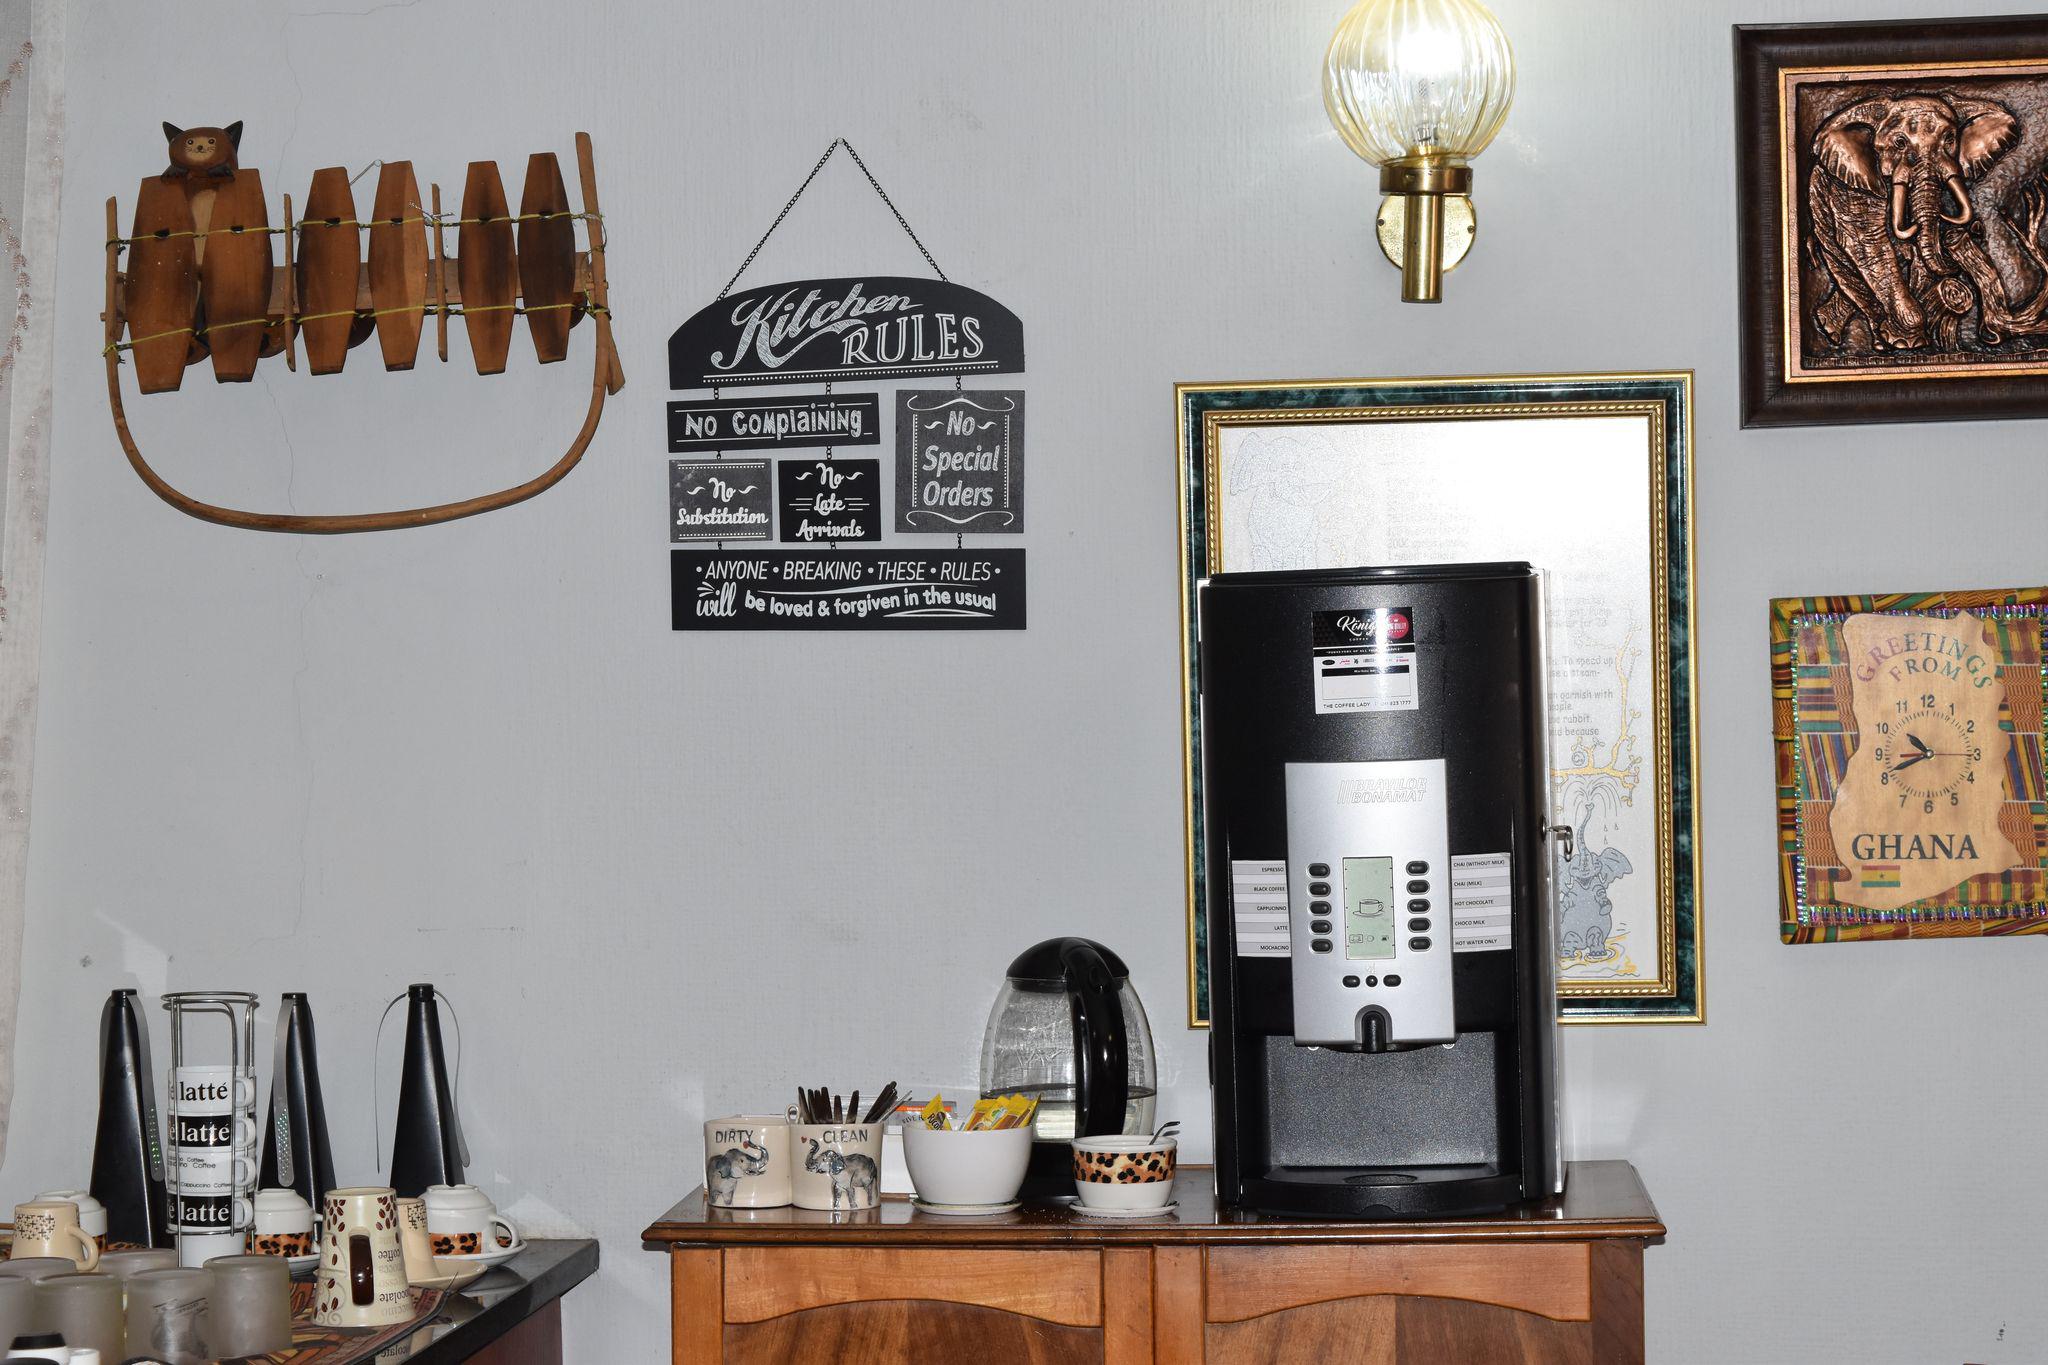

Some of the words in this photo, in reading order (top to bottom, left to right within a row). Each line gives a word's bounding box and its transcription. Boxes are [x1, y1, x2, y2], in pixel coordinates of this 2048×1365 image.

[711, 283, 923, 369] Kitchen
[840, 313, 984, 365] RULES
[685, 413, 718, 438] NO
[946, 411, 975, 436] No
[922, 445, 999, 477] Special
[816, 463, 845, 488] No
[708, 478, 736, 502] No
[923, 481, 993, 506] Orders
[814, 494, 846, 514] Late
[676, 508, 769, 526] Substitution
[796, 520, 865, 540] Arrivals
[705, 561, 769, 580] ANYONE
[783, 561, 862, 581] BREAKING
[877, 561, 927, 581] THESE
[940, 561, 991, 581] RULES
[696, 583, 737, 617] will
[744, 590, 766, 611] be
[770, 596, 813, 617] loved
[818, 602, 831, 617] &
[834, 592, 900, 617] forgiven
[904, 588, 919, 605] in
[922, 585, 950, 606] the
[955, 592, 997, 611] usual
[1576, 656, 1601, 667] speed
[1603, 657, 1614, 667] up
[1856, 632, 1993, 690] GREETINGS
[1889, 656, 1961, 682] FROM
[1560, 689, 1592, 702] garnish
[1594, 689, 1613, 699] with
[1920, 694, 1936, 709] 12
[1896, 701, 1909, 714] 11
[1949, 703, 1955, 716] 1
[1565, 727, 1599, 736] because
[1875, 722, 1889, 735] 10
[1966, 720, 1975, 733] 2
[1875, 748, 1884, 761] 9
[1973, 748, 1982, 761] 3
[1880, 772, 1889, 785] 8
[1966, 771, 1975, 784] 4
[1899, 795, 1908, 808] 7
[1924, 800, 1934, 814] 6
[1950, 793, 1959, 806] 5
[1851, 833, 1981, 861] GHANA
[180, 1081, 228, 1101] latté
[181, 1121, 230, 1142] latté
[715, 1129, 754, 1143] DIRTY
[823, 1130, 868, 1143] CLEAN
[180, 1202, 230, 1222] latté
